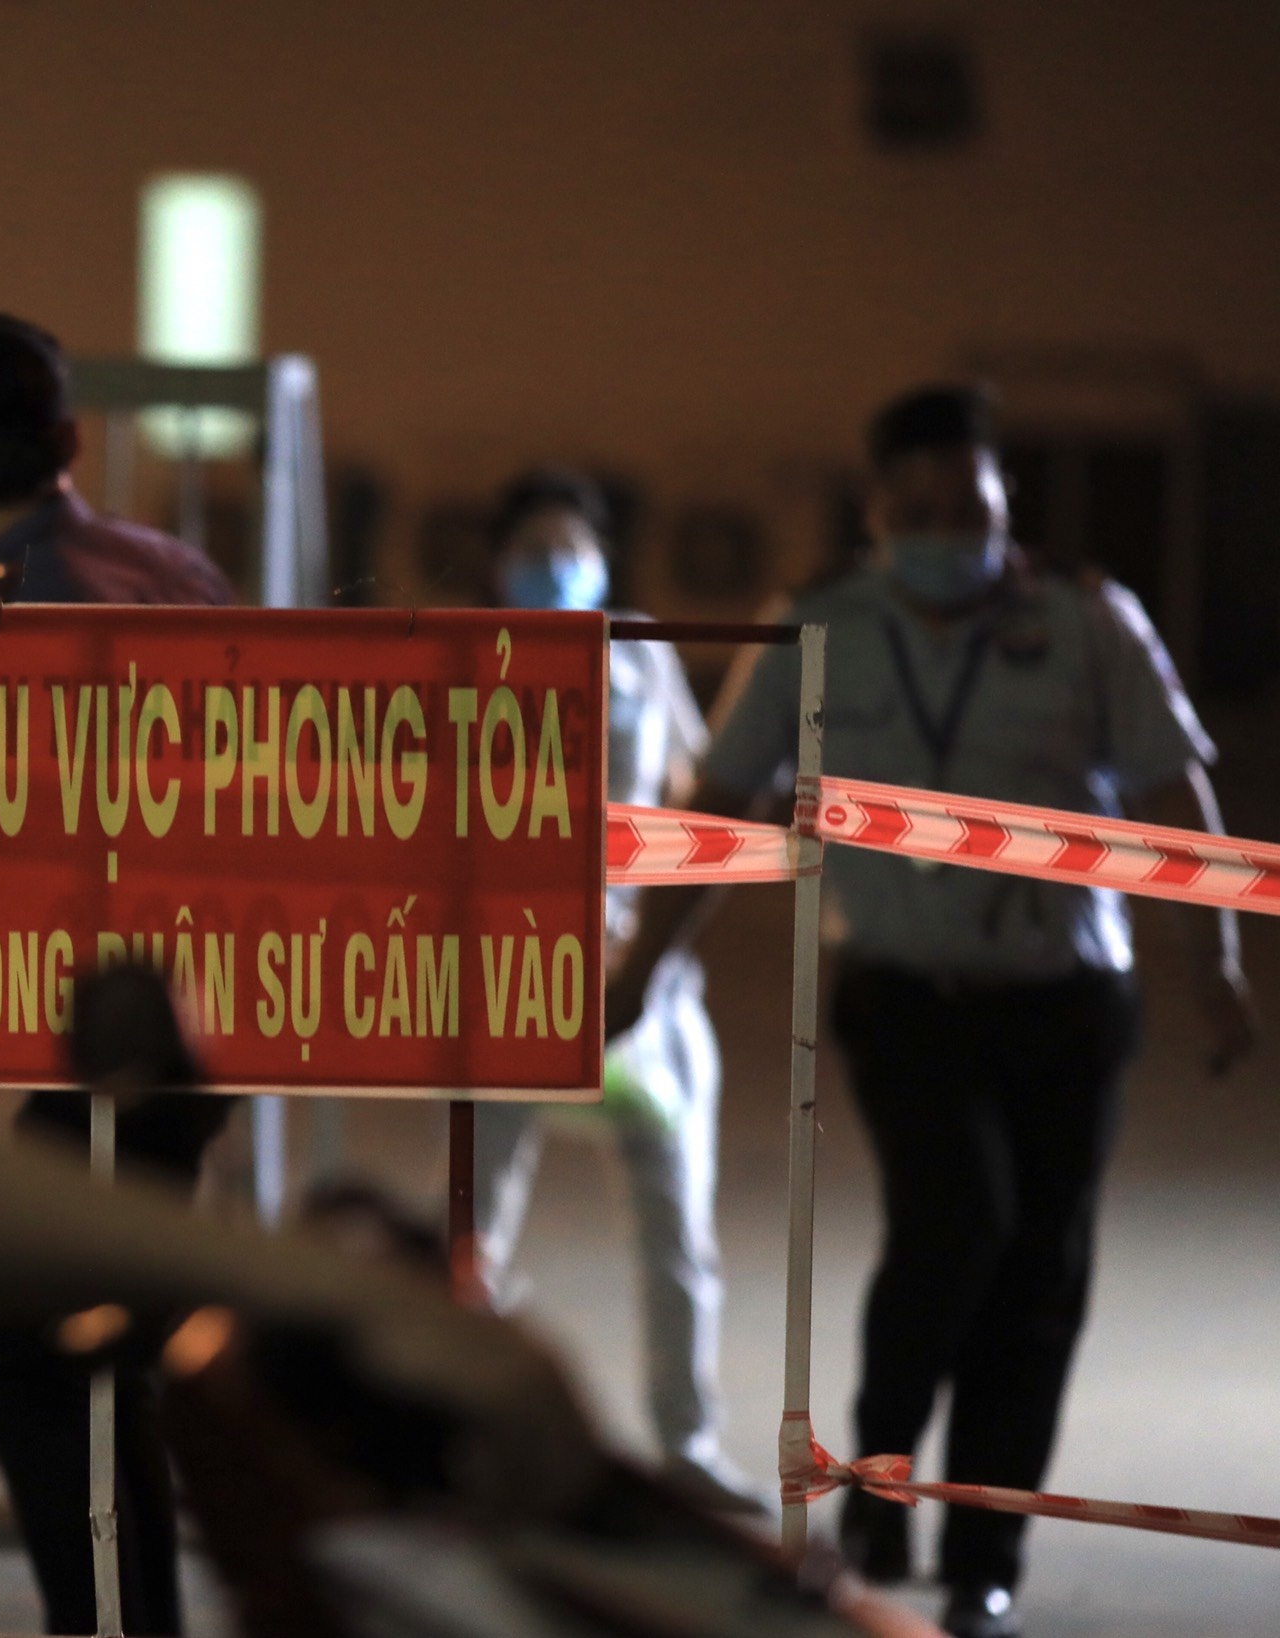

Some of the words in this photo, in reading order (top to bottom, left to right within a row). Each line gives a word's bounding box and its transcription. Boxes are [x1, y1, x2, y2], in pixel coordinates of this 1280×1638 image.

[51, 660, 182, 884] VỰC
[203, 684, 428, 840] PHONG
[448, 628, 572, 841] TỎA
[256, 917, 327, 1062] SỰ
[343, 895, 460, 1040] CẤM
[480, 908, 585, 1041] VÀO
